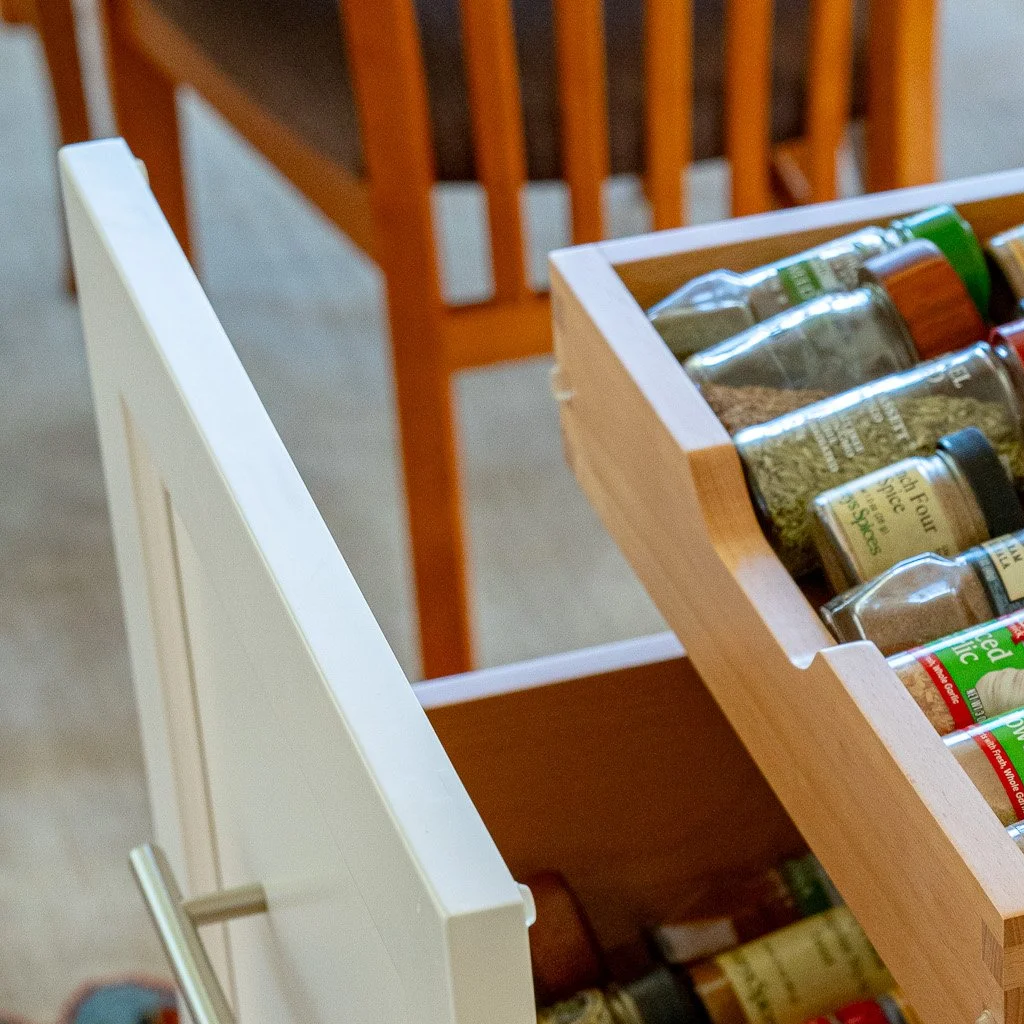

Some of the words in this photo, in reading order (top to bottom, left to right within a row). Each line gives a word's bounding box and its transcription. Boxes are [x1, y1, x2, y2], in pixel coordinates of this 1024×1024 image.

[910, 492, 938, 533] Four
[975, 633, 1014, 663] ced
[944, 681, 960, 705] Garlic
[1003, 768, 1020, 792] Whole
